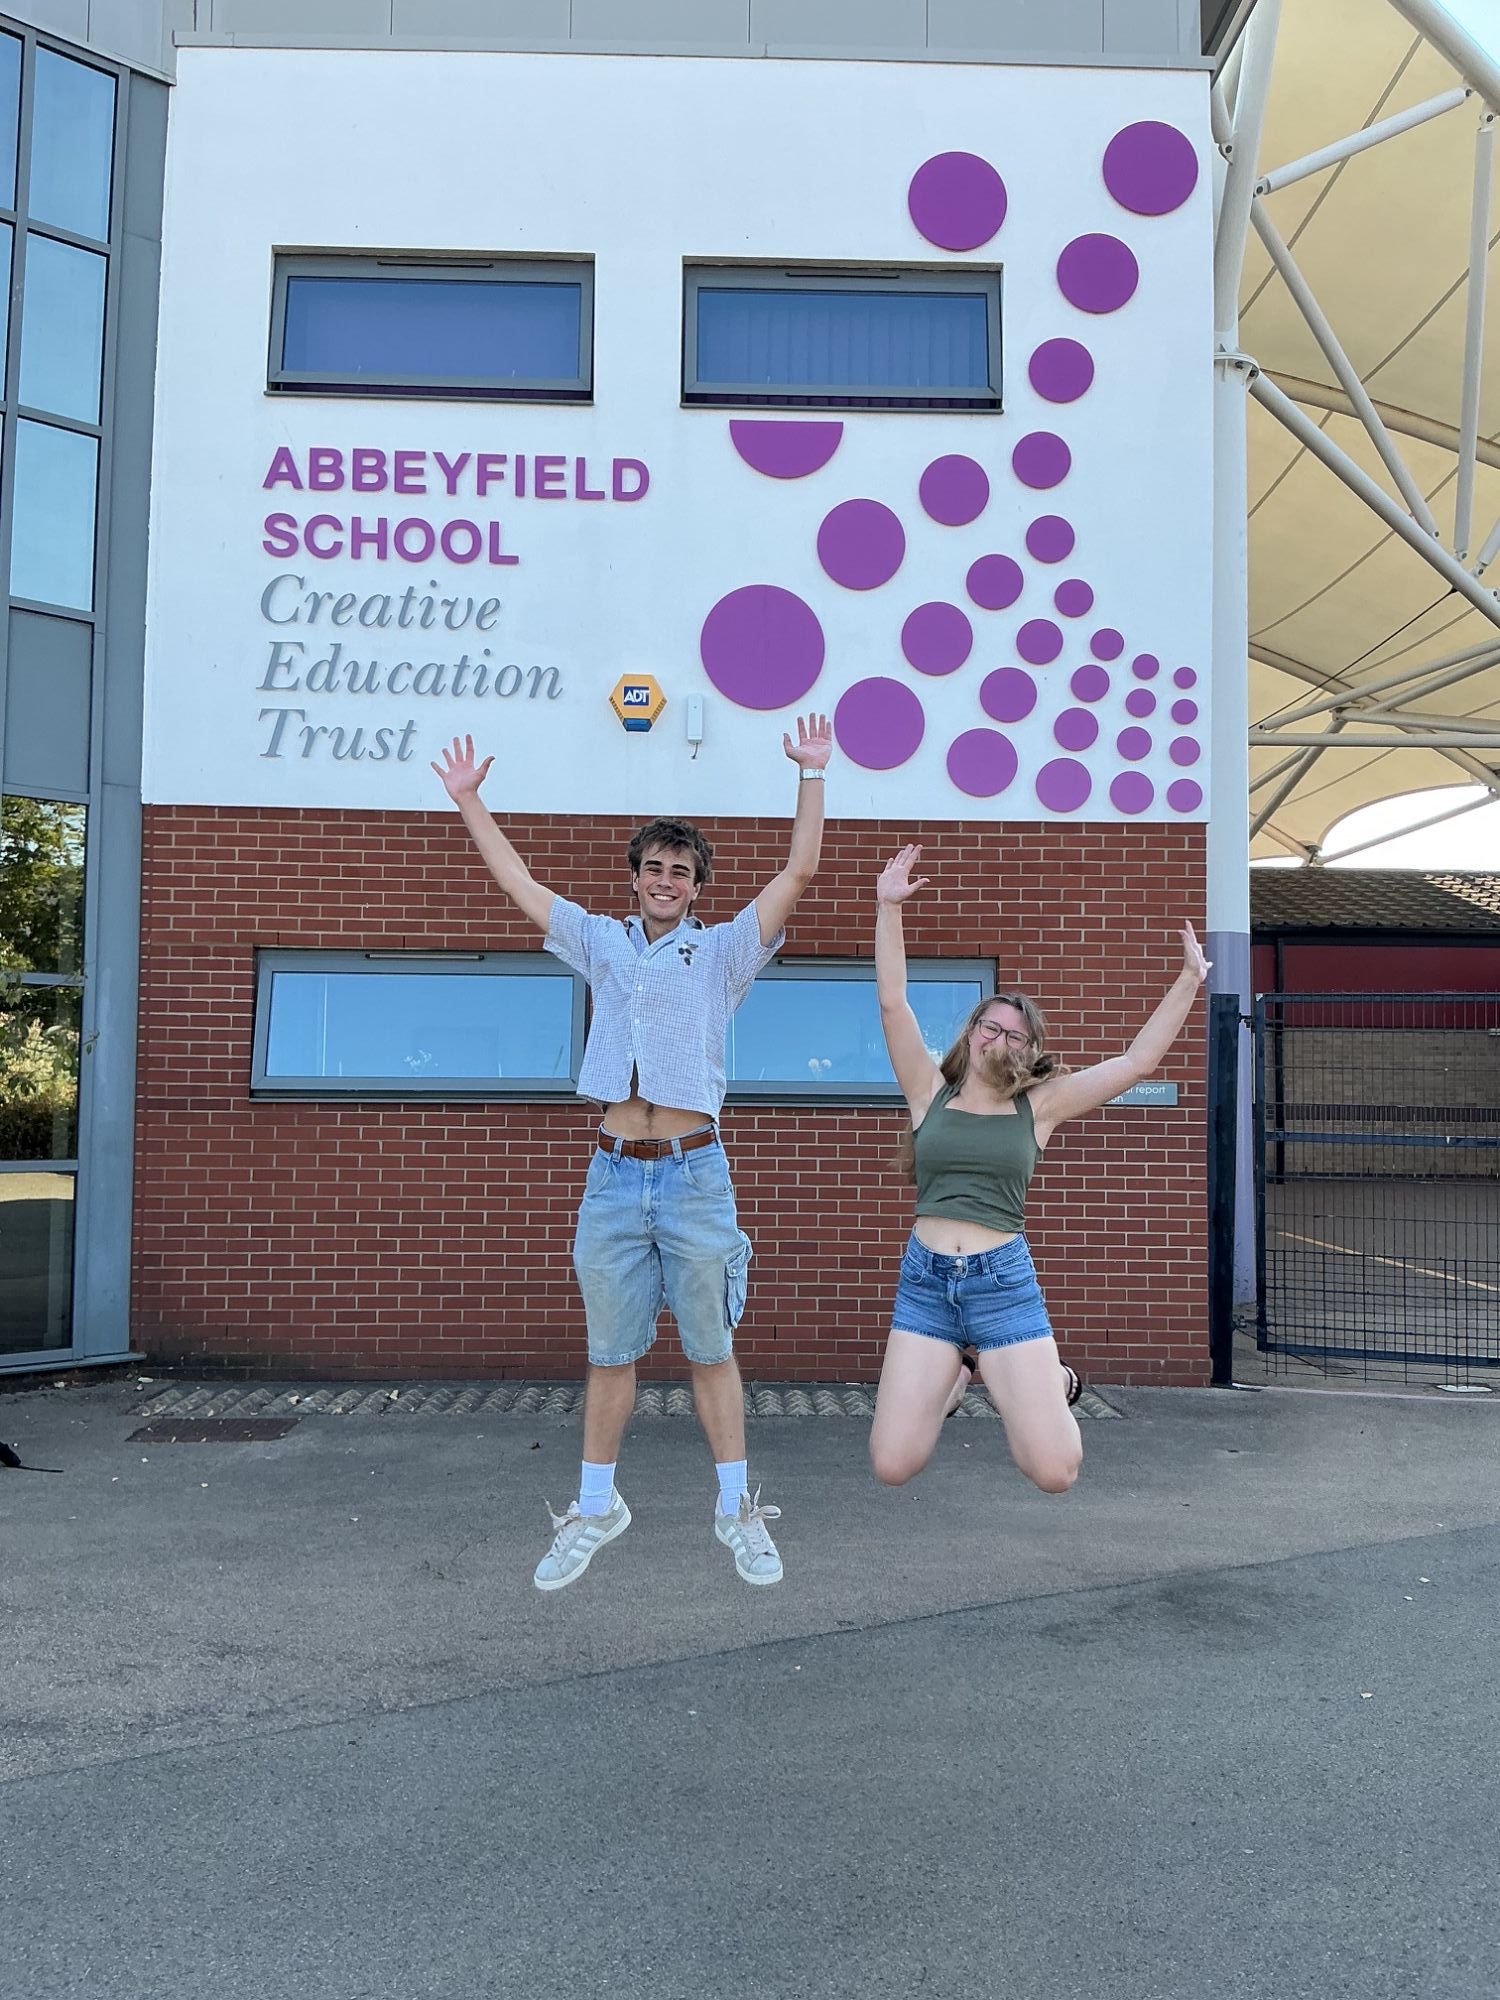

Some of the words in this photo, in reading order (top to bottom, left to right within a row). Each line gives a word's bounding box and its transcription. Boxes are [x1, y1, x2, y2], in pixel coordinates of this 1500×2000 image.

[262, 446, 650, 502] ABBEYFIELD
[262, 513, 519, 566] SCHOOL
[261, 574, 502, 631] Creative
[256, 641, 563, 700] Education
[624, 689, 650, 703] ADT
[258, 708, 418, 762] Trust
[1135, 1086, 1166, 1096] report
